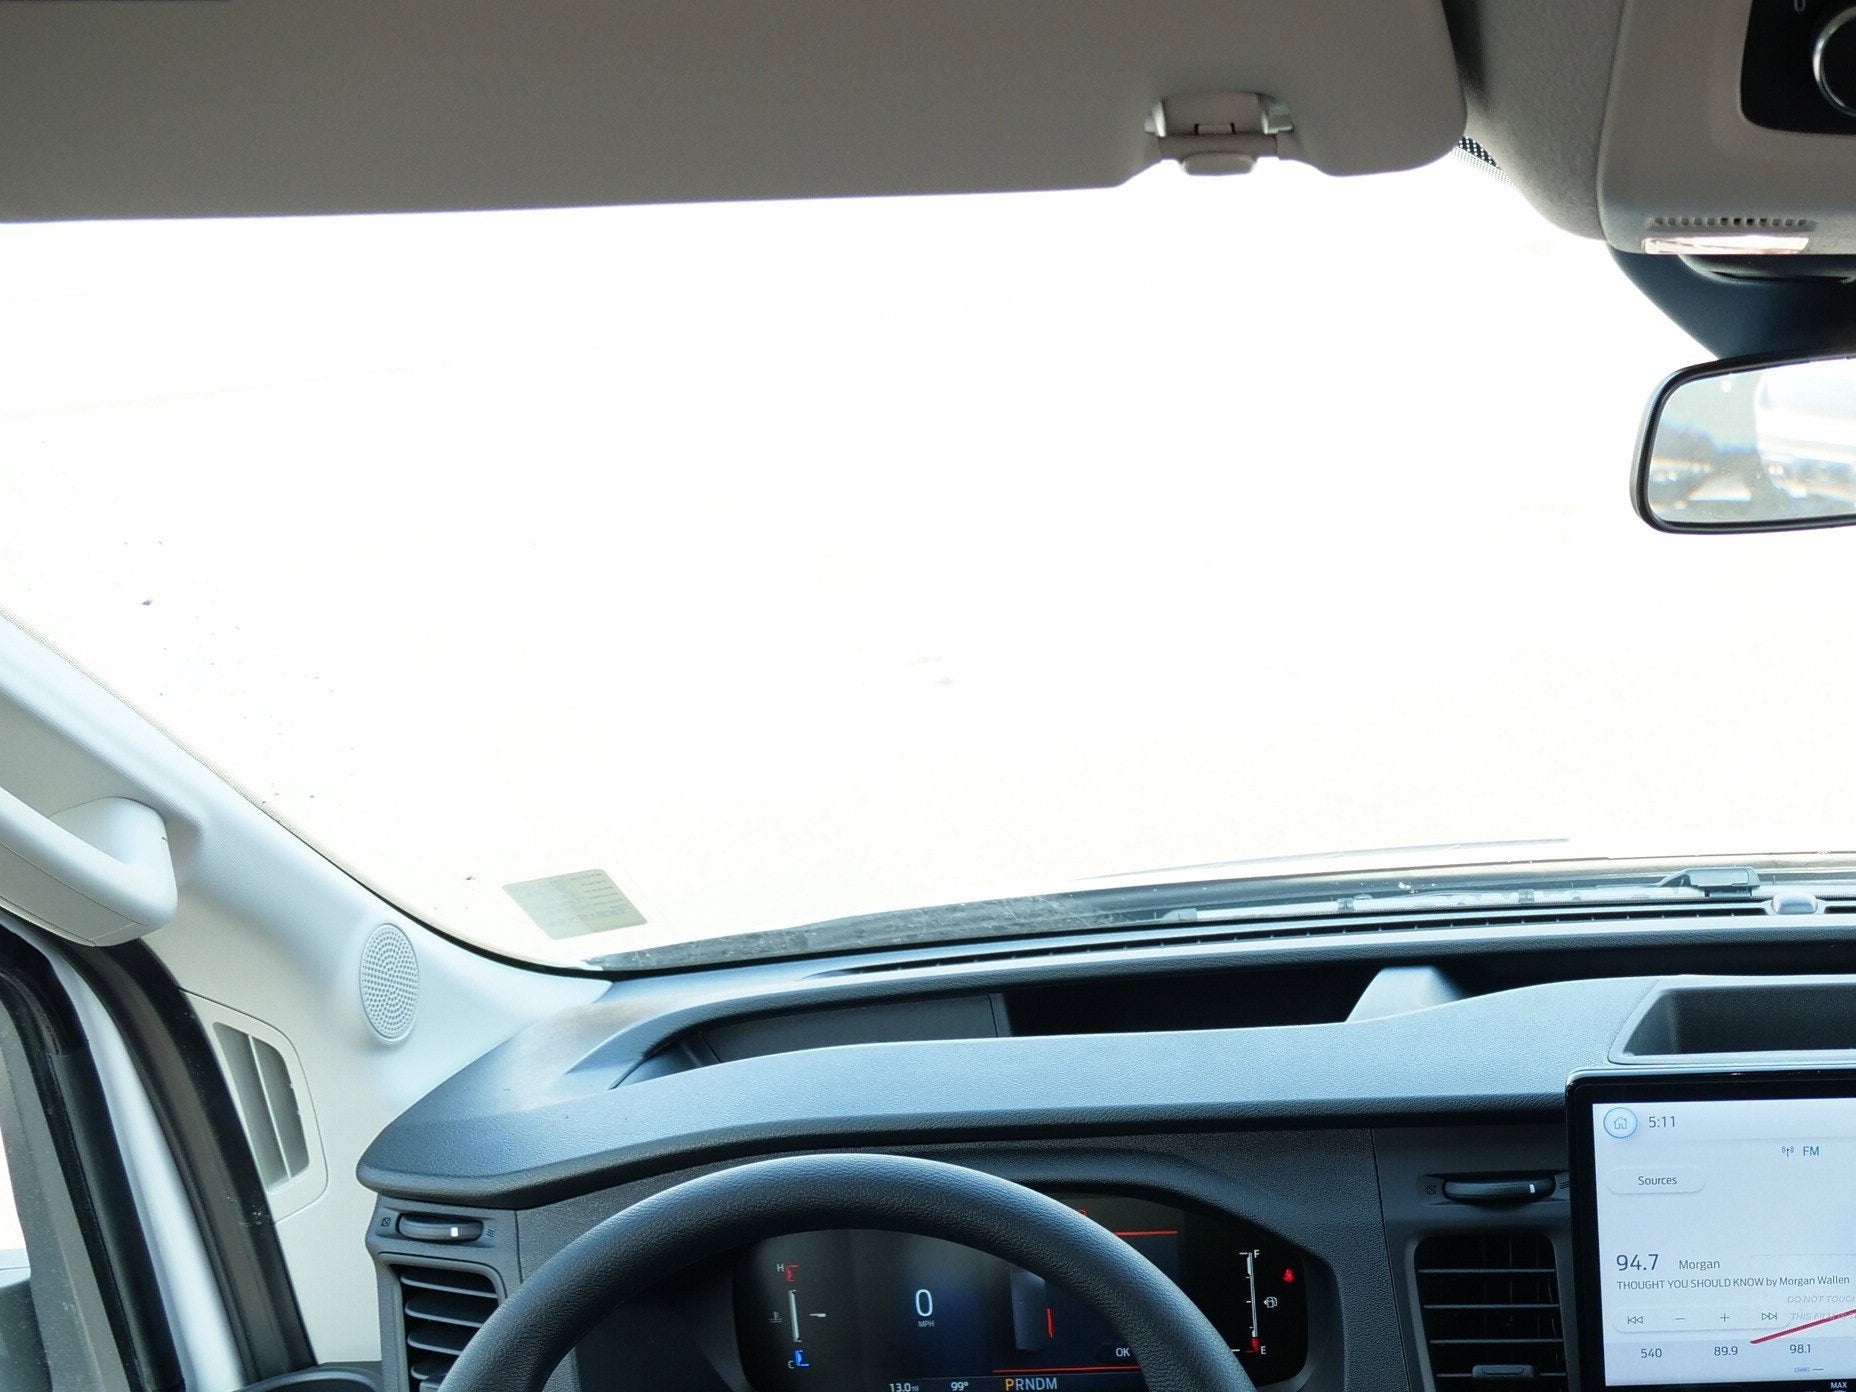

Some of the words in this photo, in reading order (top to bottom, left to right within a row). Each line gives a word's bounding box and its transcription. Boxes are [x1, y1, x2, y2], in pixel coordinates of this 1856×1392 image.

[1648, 1115, 1676, 1128] 5:11
[1802, 1146, 1820, 1157] FM
[1637, 1175, 1678, 1186] Sources
[1253, 1249, 1260, 1259] F
[776, 1263, 785, 1272] H
[1616, 1253, 1659, 1271] 94.7
[1679, 1258, 1721, 1272] Morgan
[1617, 1280, 1665, 1290] THOUGHT
[1667, 1279, 1689, 1289] YOU
[1690, 1278, 1731, 1289] SHOULD
[1733, 1277, 1764, 1287] KNOW
[1766, 1276, 1777, 1288] by
[1779, 1276, 1815, 1288] Morgan
[1817, 1275, 1850, 1285] Wallen
[915, 1288, 934, 1317] 0
[918, 1320, 935, 1328] MPH
[1115, 1347, 1131, 1357] OK
[1260, 1345, 1267, 1355] E
[1640, 1348, 1663, 1358] 540
[1713, 1346, 1738, 1356] 89.9
[1789, 1344, 1811, 1354] 98.1
[787, 1360, 795, 1369] C
[1830, 1381, 1847, 1389] MAX
